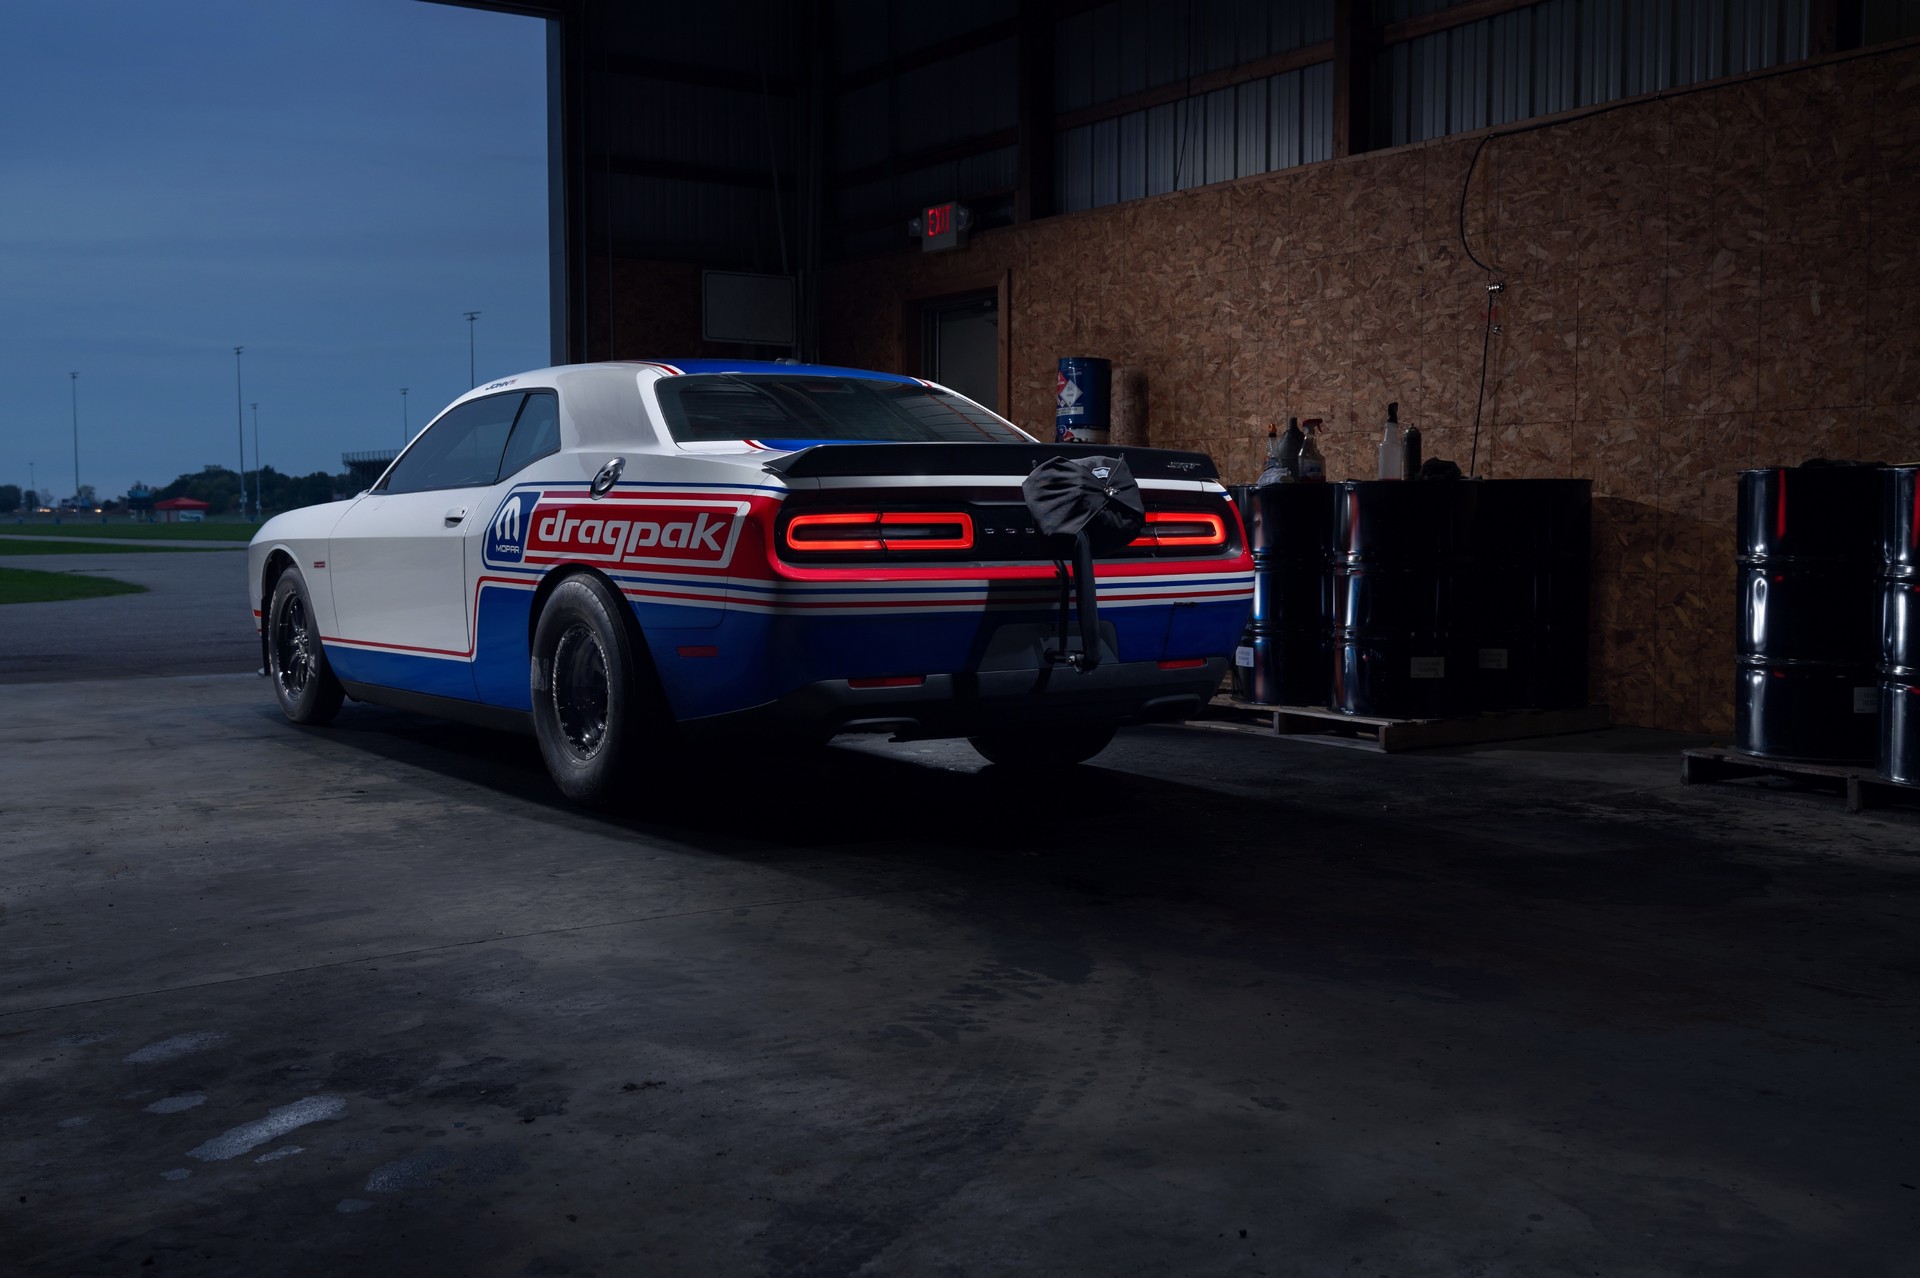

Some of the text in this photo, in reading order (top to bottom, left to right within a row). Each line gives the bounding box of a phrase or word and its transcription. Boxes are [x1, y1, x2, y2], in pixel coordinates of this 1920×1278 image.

[927, 204, 952, 237] EXIT
[495, 544, 520, 554] MOPAR
[538, 509, 726, 560] dragpak
